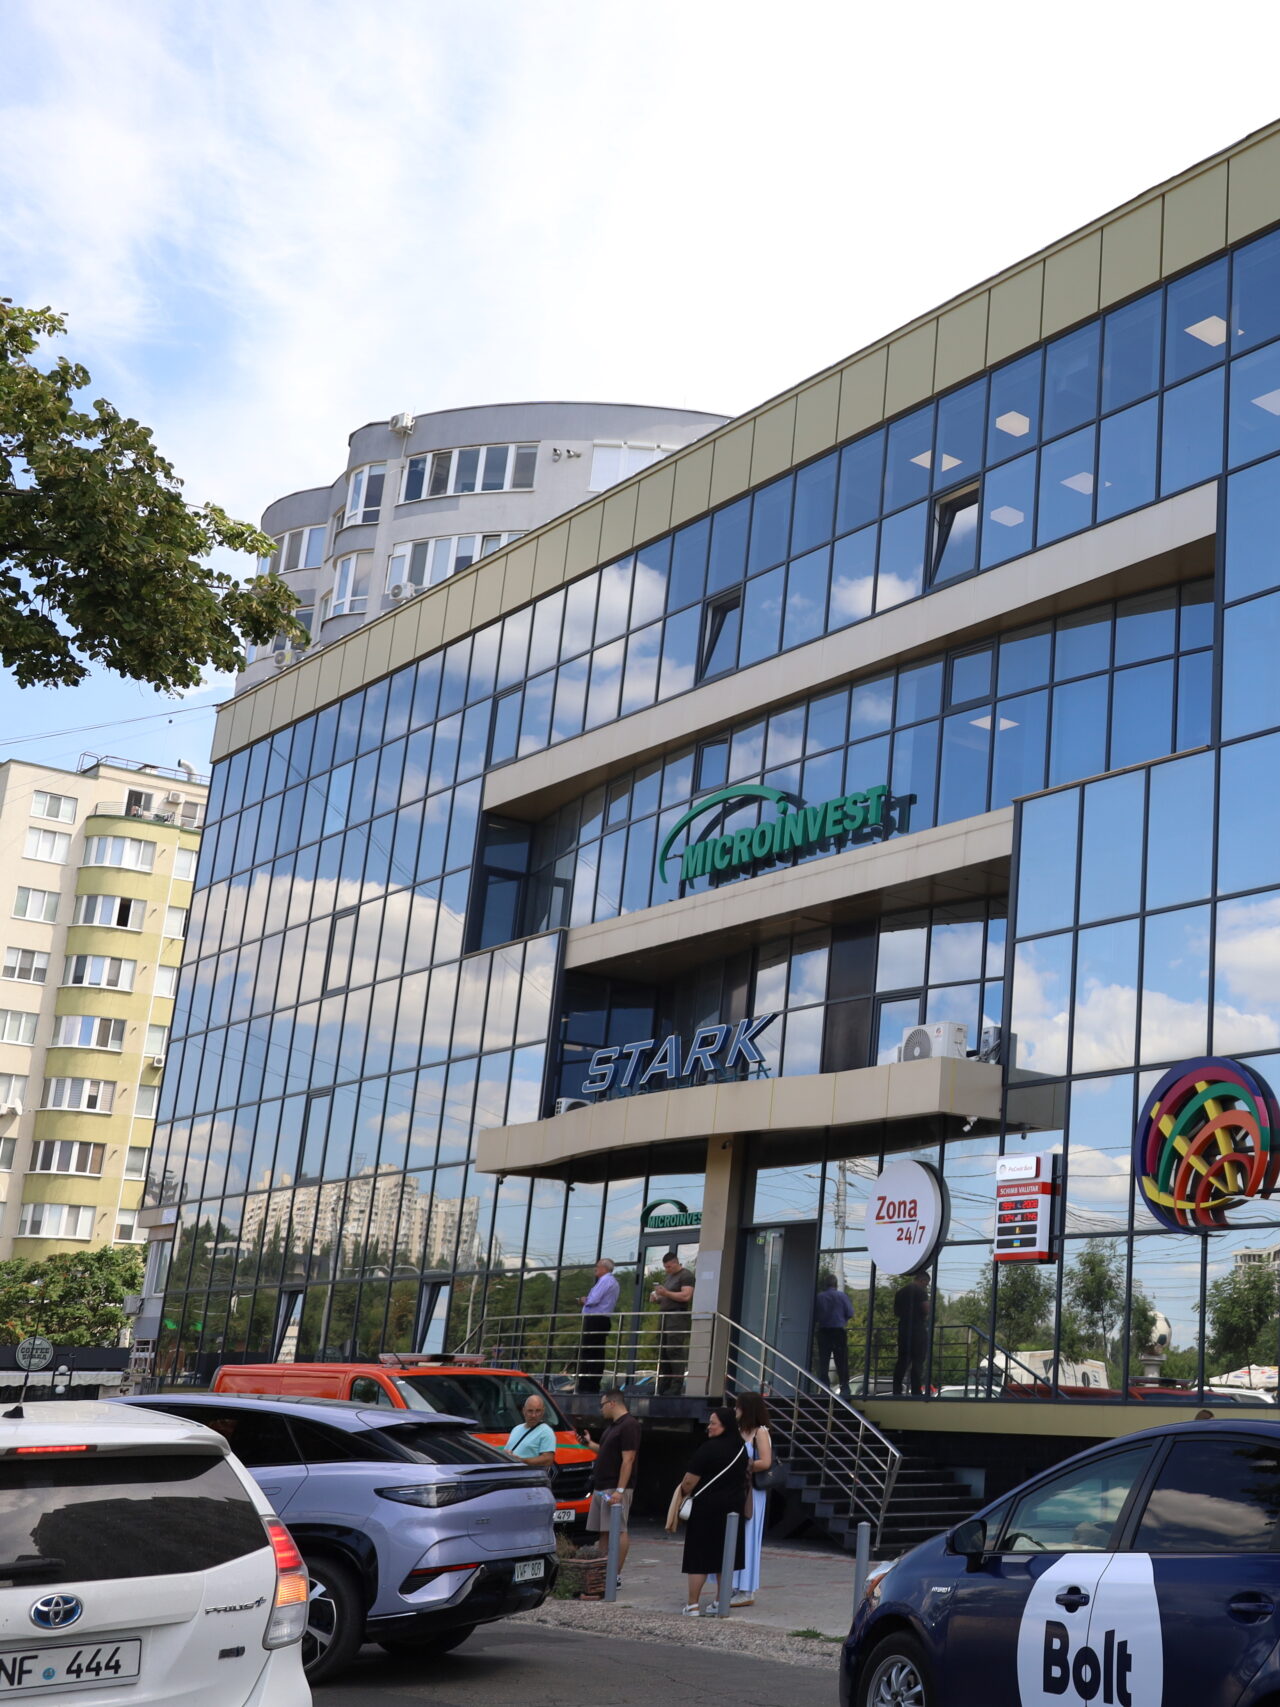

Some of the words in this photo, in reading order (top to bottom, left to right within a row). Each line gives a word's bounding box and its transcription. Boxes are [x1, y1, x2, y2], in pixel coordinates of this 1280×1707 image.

[681, 784, 888, 881] MICROINVEST
[581, 1013, 777, 1093] STARK
[647, 1212, 704, 1228] MICROINVES
[875, 1195, 918, 1221] Zona
[896, 1220, 926, 1245] 24/7
[66, 1646, 122, 1680] 444
[1043, 1619, 1133, 1707] Bolt
